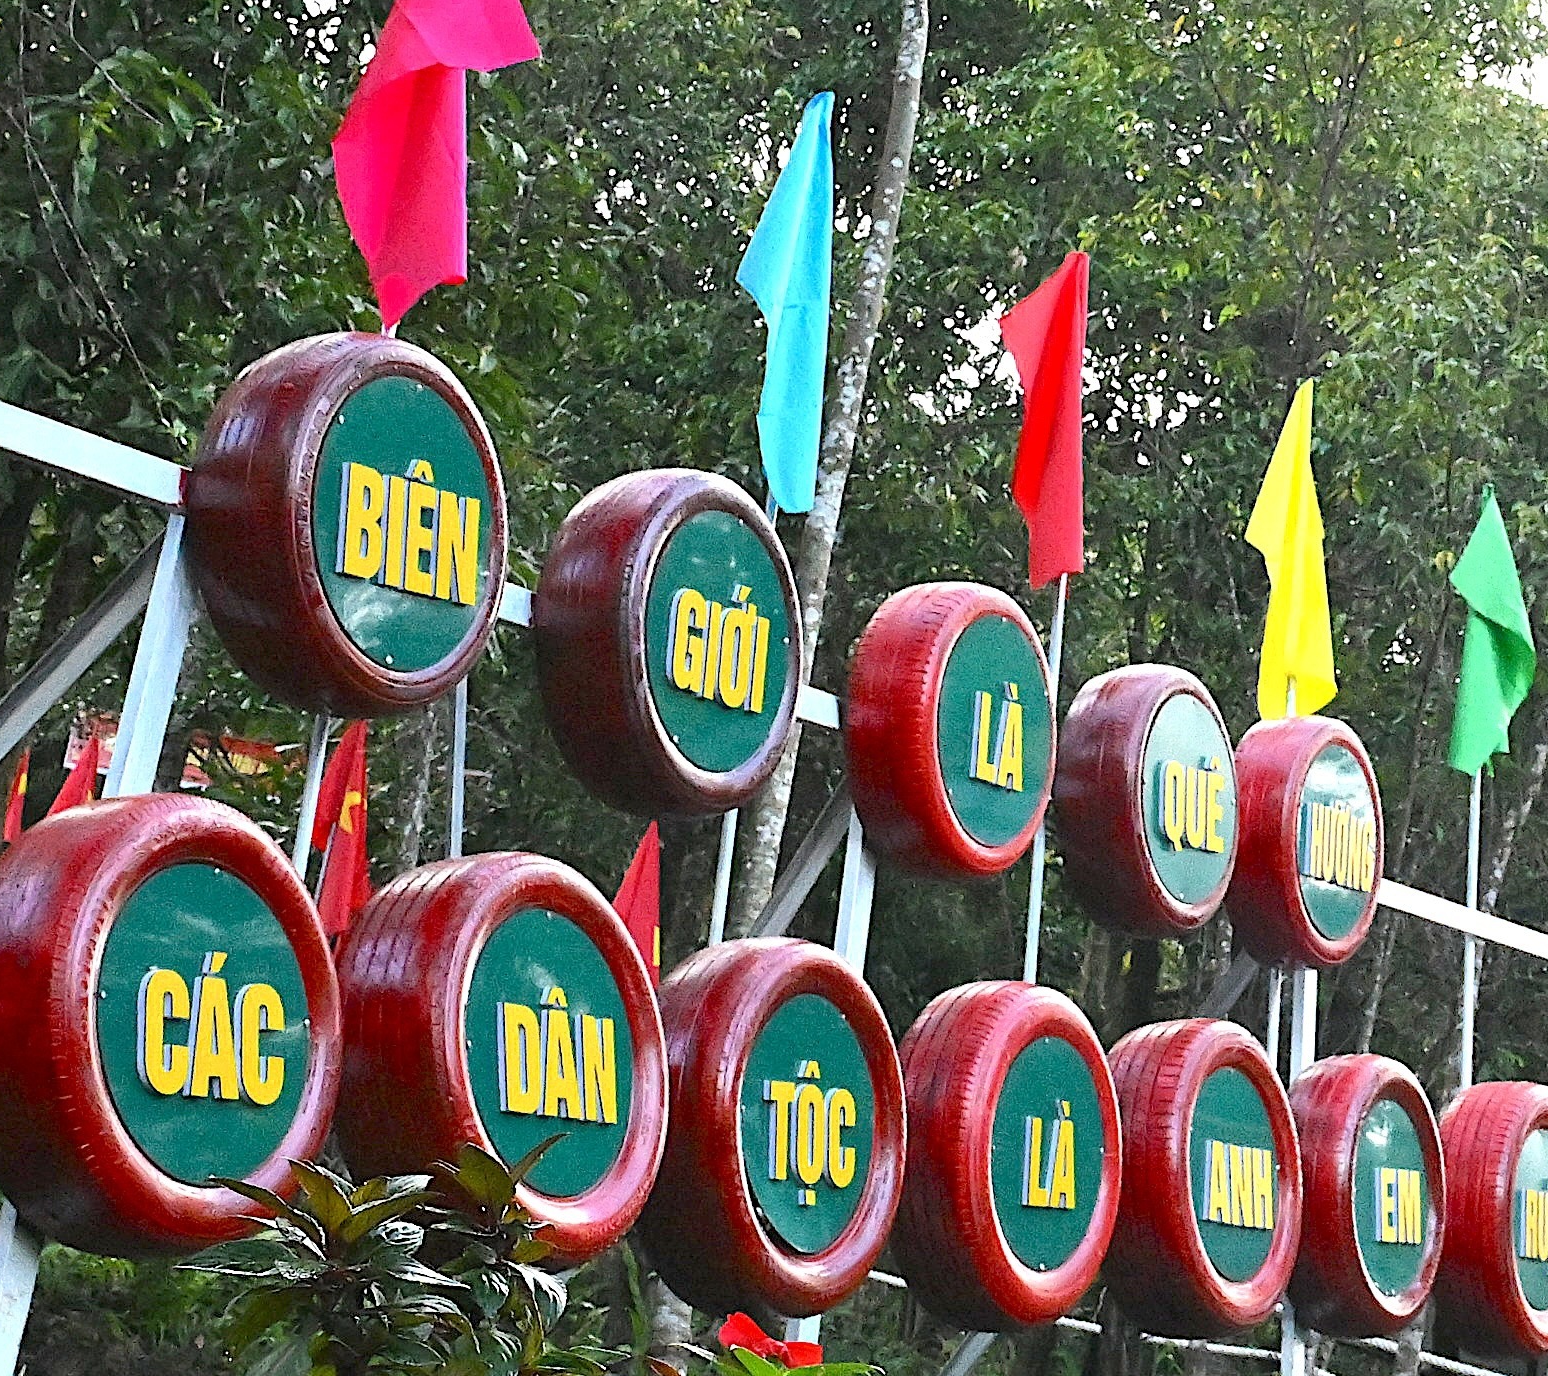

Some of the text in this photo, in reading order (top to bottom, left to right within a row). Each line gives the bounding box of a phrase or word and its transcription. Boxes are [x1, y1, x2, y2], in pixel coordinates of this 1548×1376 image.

[335, 459, 1376, 893] BIÊN GIỚI LÀ QUÊ HƯƠNG
[137, 951, 286, 1106] CÁC
[496, 988, 617, 1124] DÂN
[762, 1060, 857, 1206] TỘC
[1021, 1099, 1077, 1210] LÀ
[1202, 1139, 1274, 1230] ANH
[1374, 1166, 1423, 1245] EM
